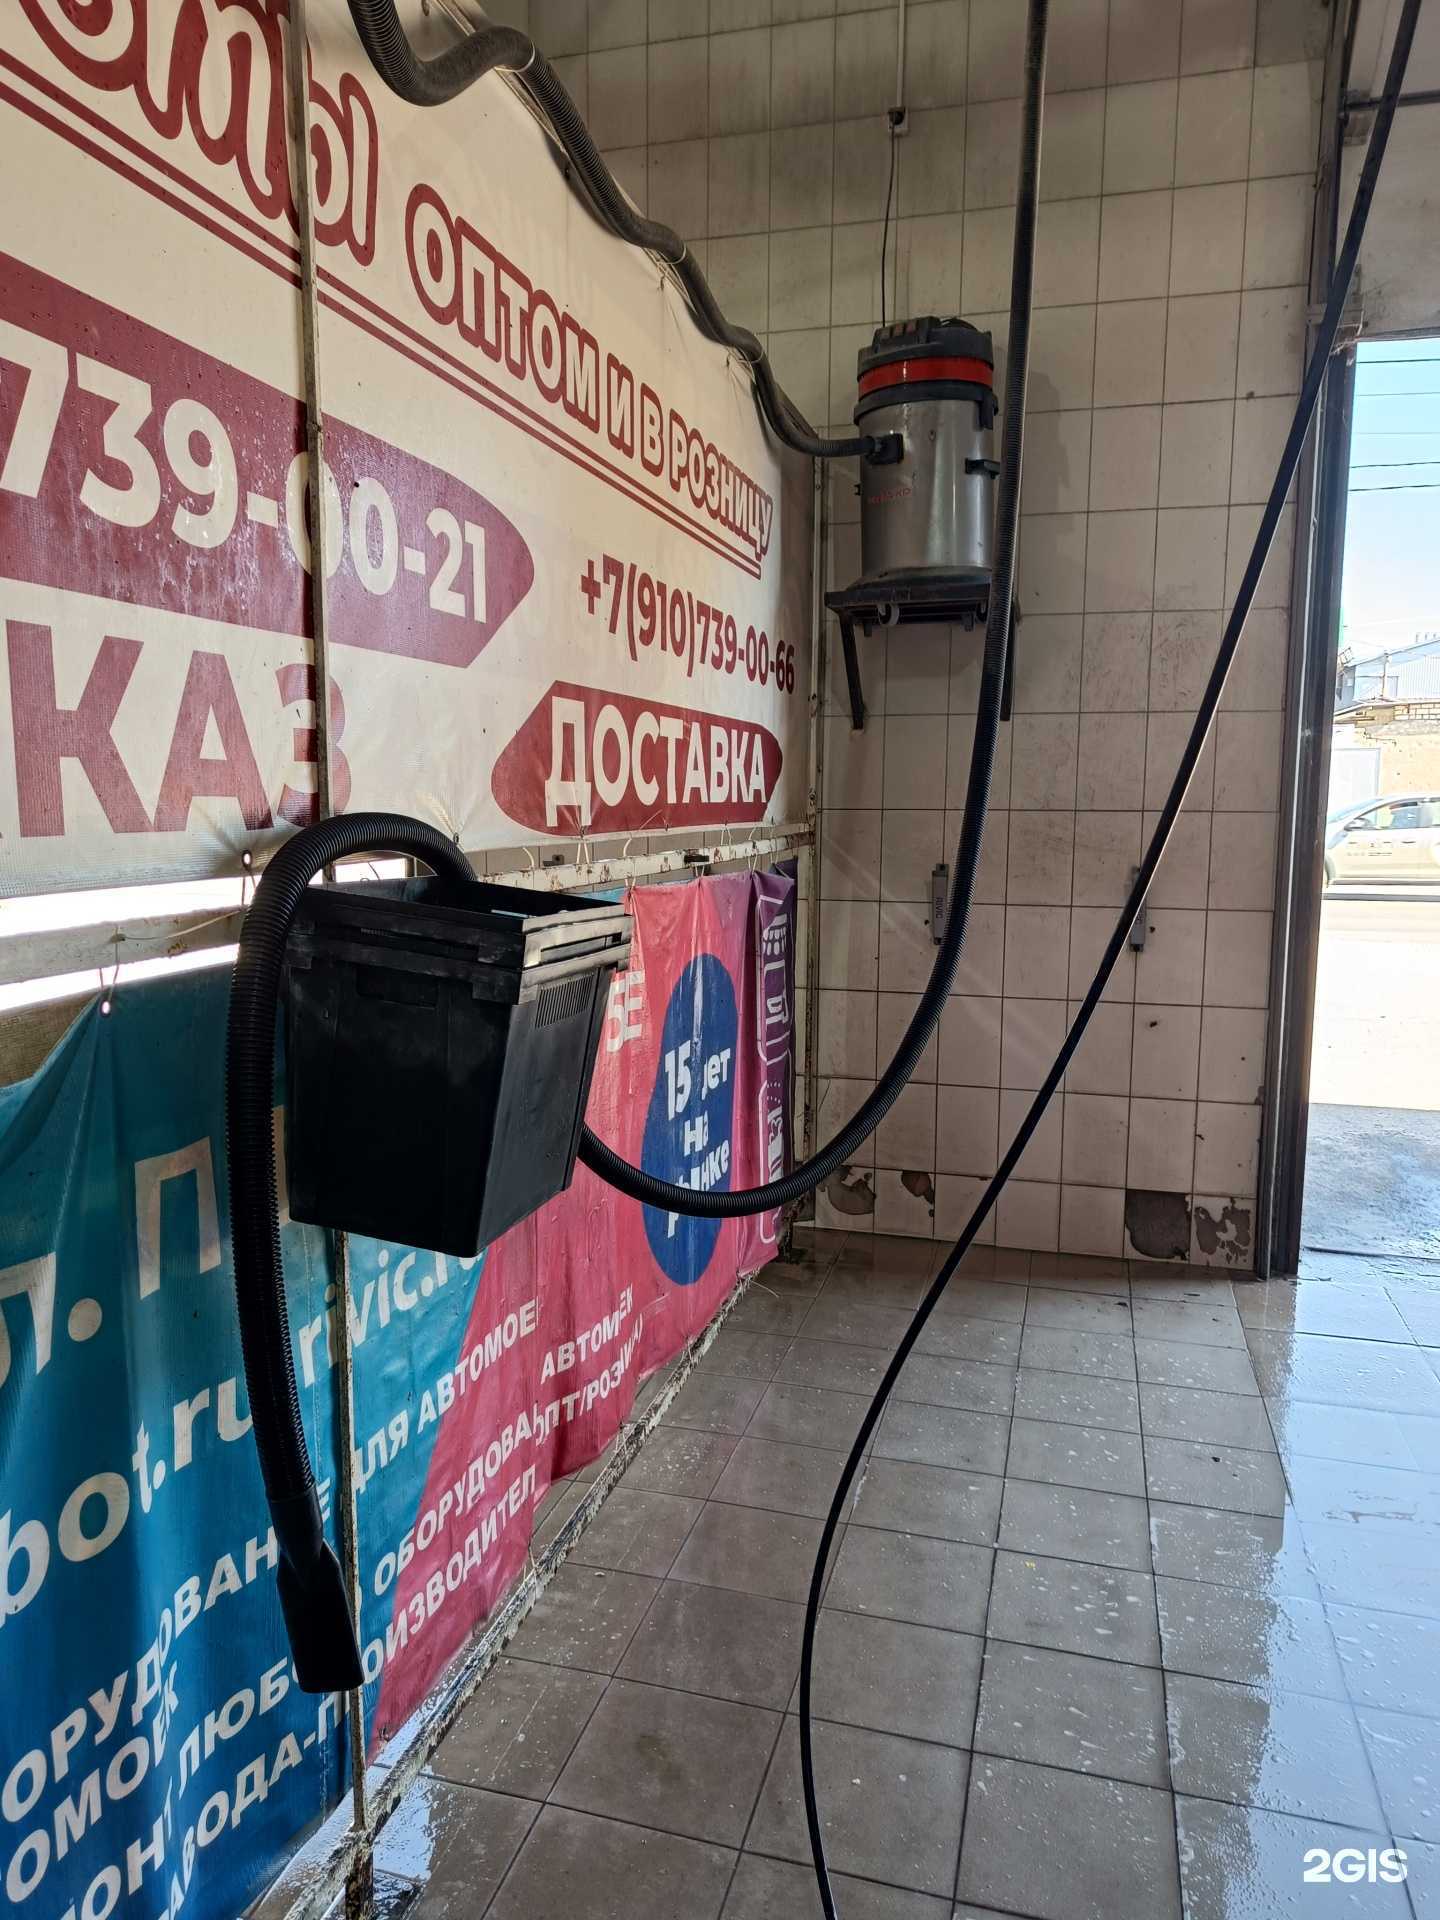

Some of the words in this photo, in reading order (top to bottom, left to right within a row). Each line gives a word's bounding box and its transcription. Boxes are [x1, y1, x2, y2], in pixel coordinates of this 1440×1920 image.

[405, 183, 600, 434] ОПТОМ
[607, 352, 635, 460] И
[640, 382, 664, 477] В
[669, 408, 774, 562] РОЗНИЦУ
[545, 695, 767, 827] ДОСТАВКА
[664, 1039, 692, 1121] 15
[417, 1295, 539, 1436] АВТОМОЕ
